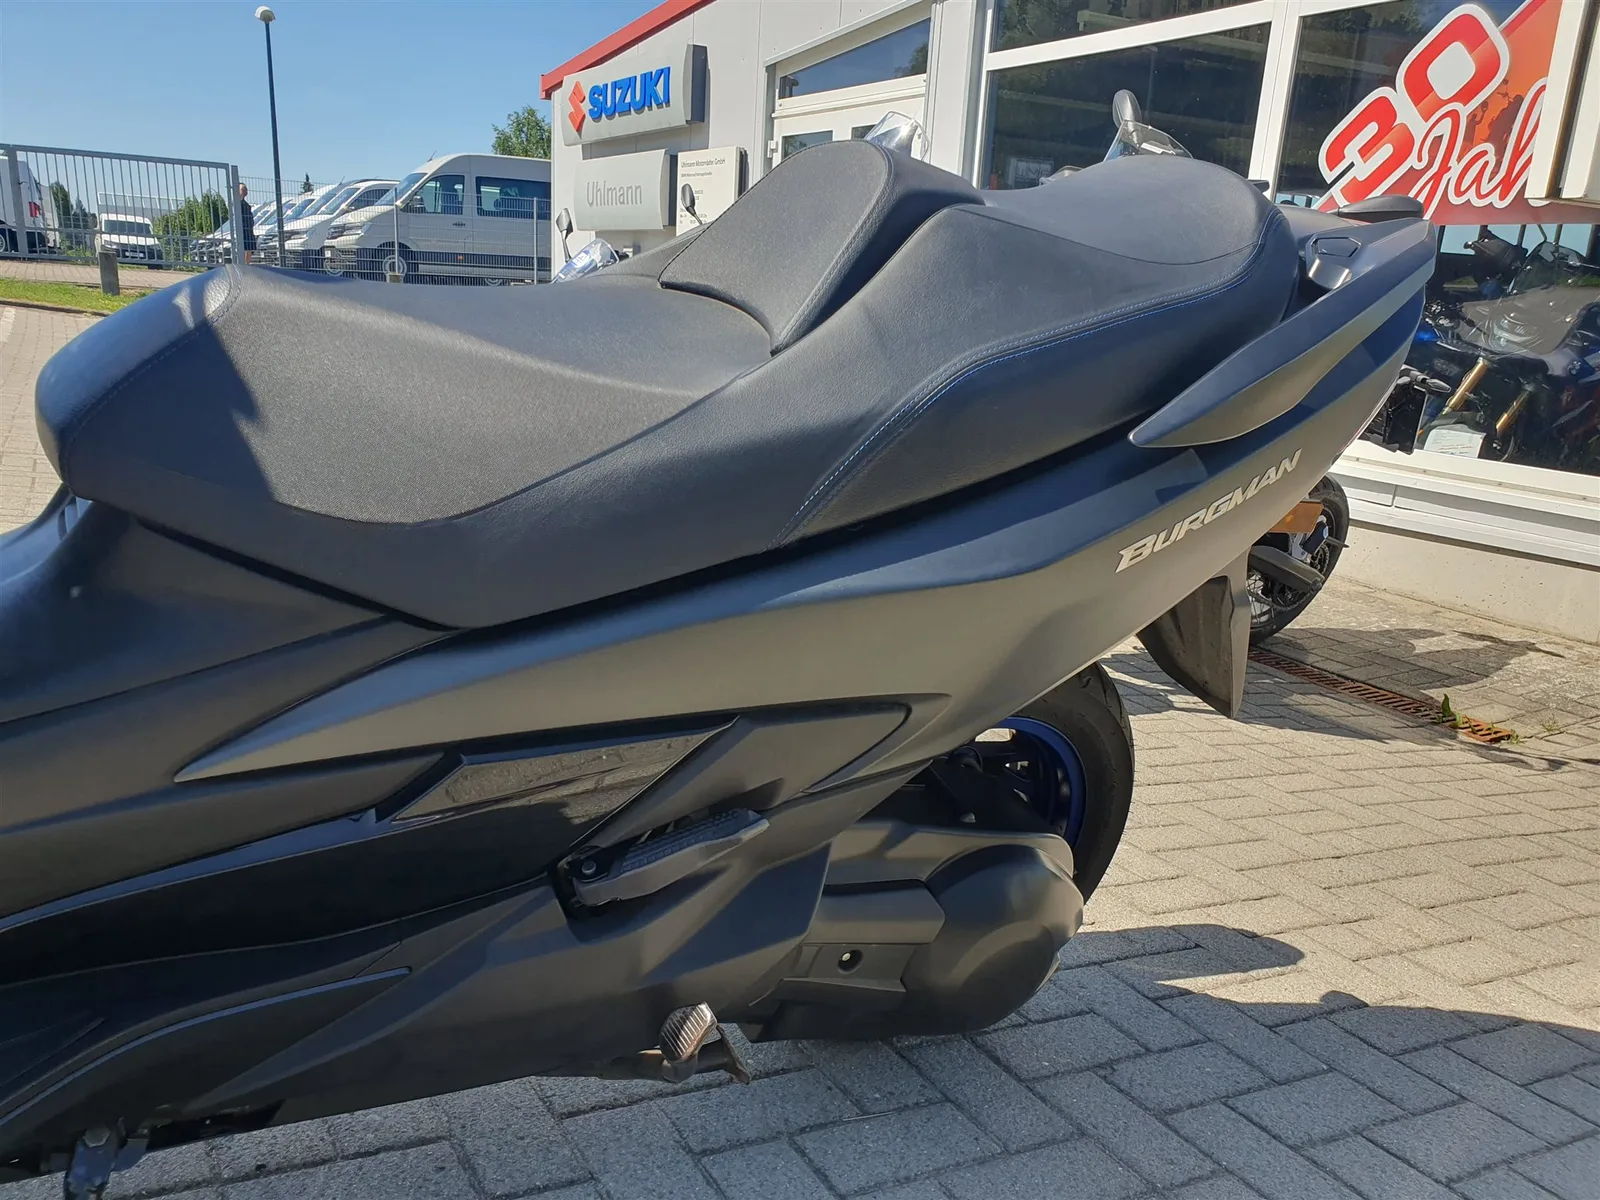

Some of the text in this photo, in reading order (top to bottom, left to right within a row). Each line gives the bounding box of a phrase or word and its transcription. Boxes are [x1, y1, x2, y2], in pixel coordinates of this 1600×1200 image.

[588, 66, 671, 122] SUZUKI
[1322, 8, 1506, 205] 30
[586, 181, 643, 208] Uhlmann
[1115, 448, 1303, 574] BURGMAN
